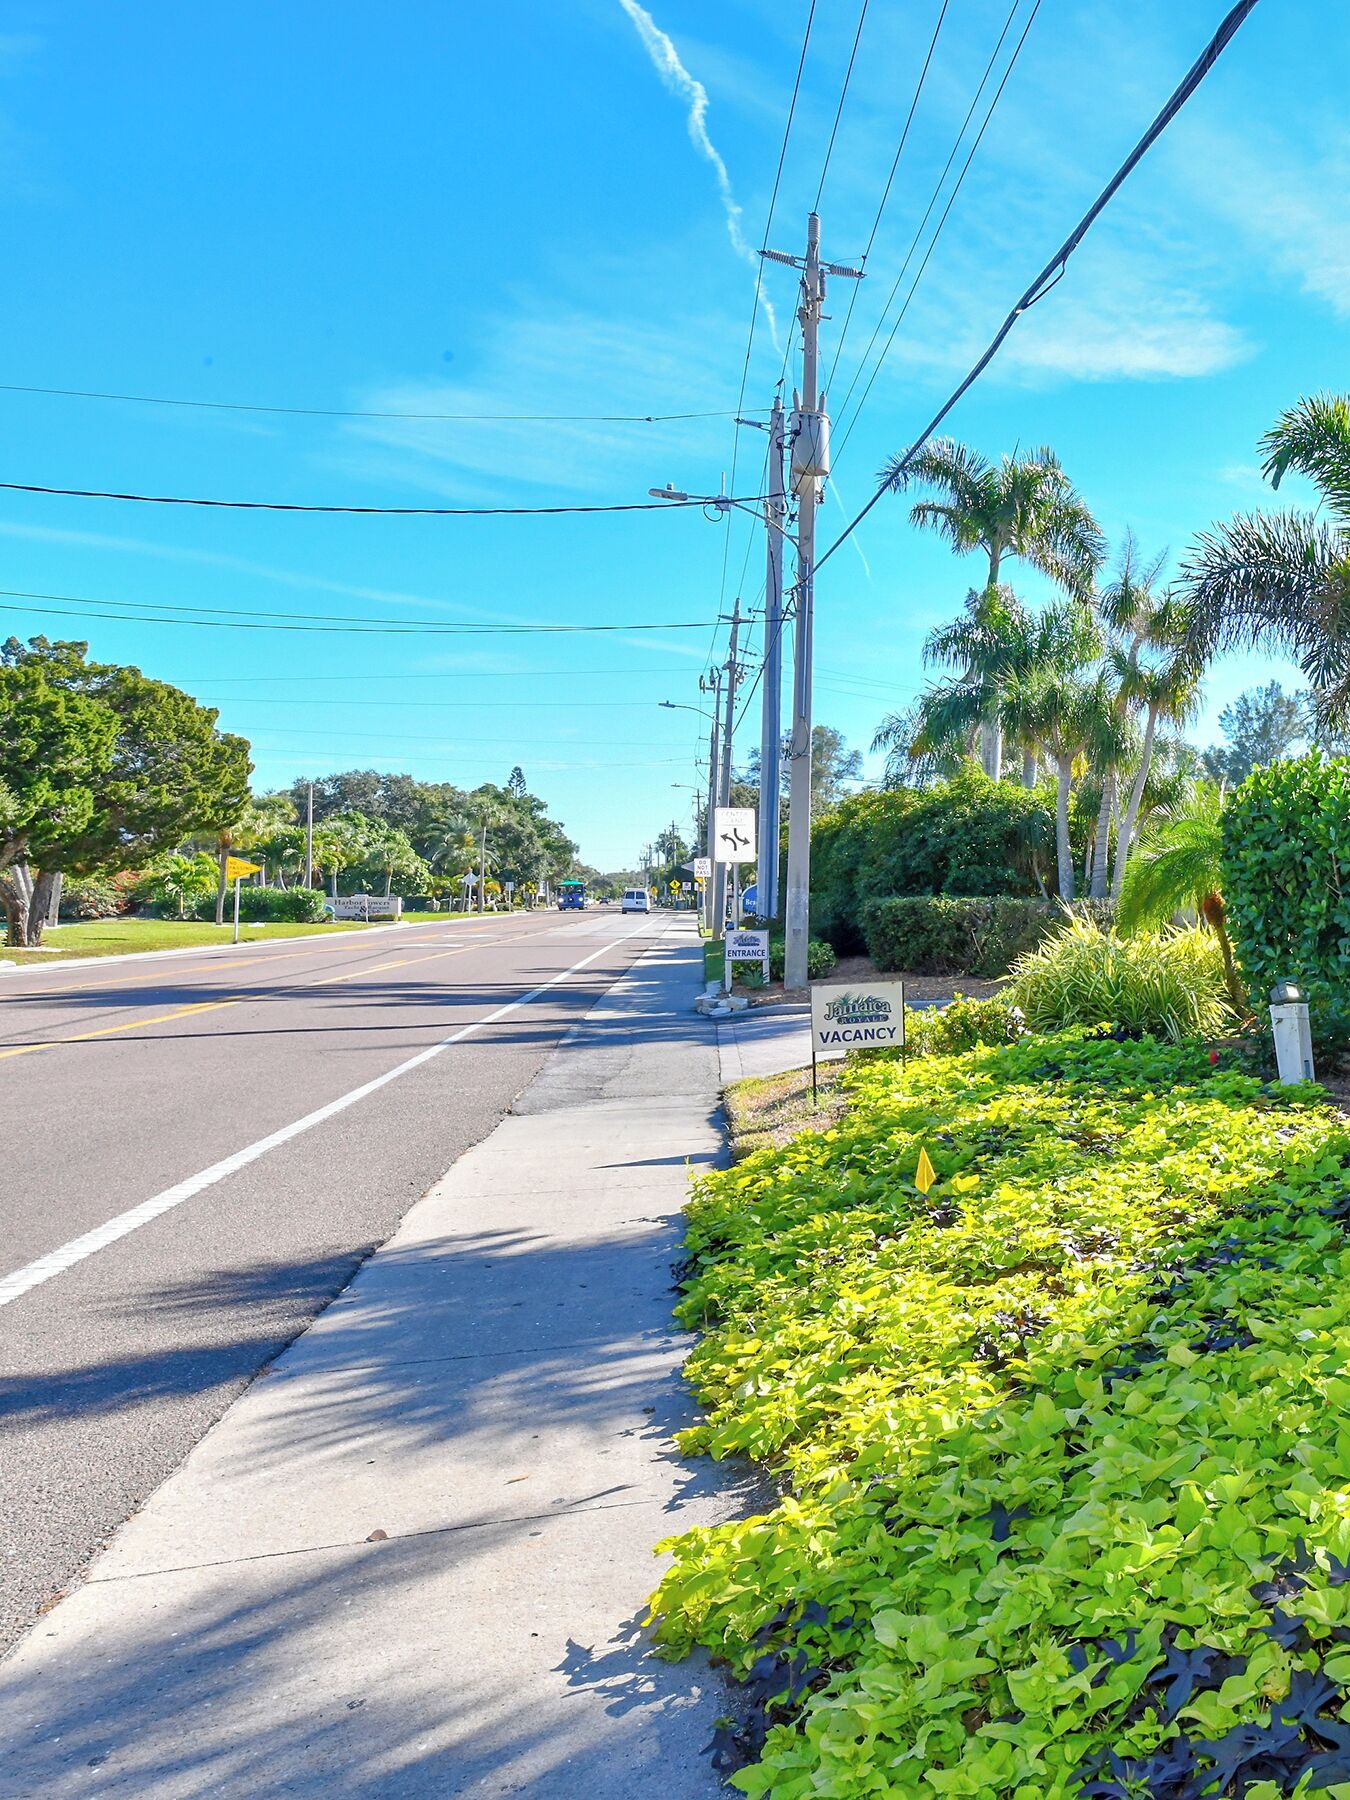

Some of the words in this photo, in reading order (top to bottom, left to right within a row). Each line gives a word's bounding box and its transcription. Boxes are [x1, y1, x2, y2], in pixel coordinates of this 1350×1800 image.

[727, 949, 766, 957] ENTRANCE
[823, 998, 892, 1020] Jamaica
[819, 1026, 897, 1044] VACANCY
